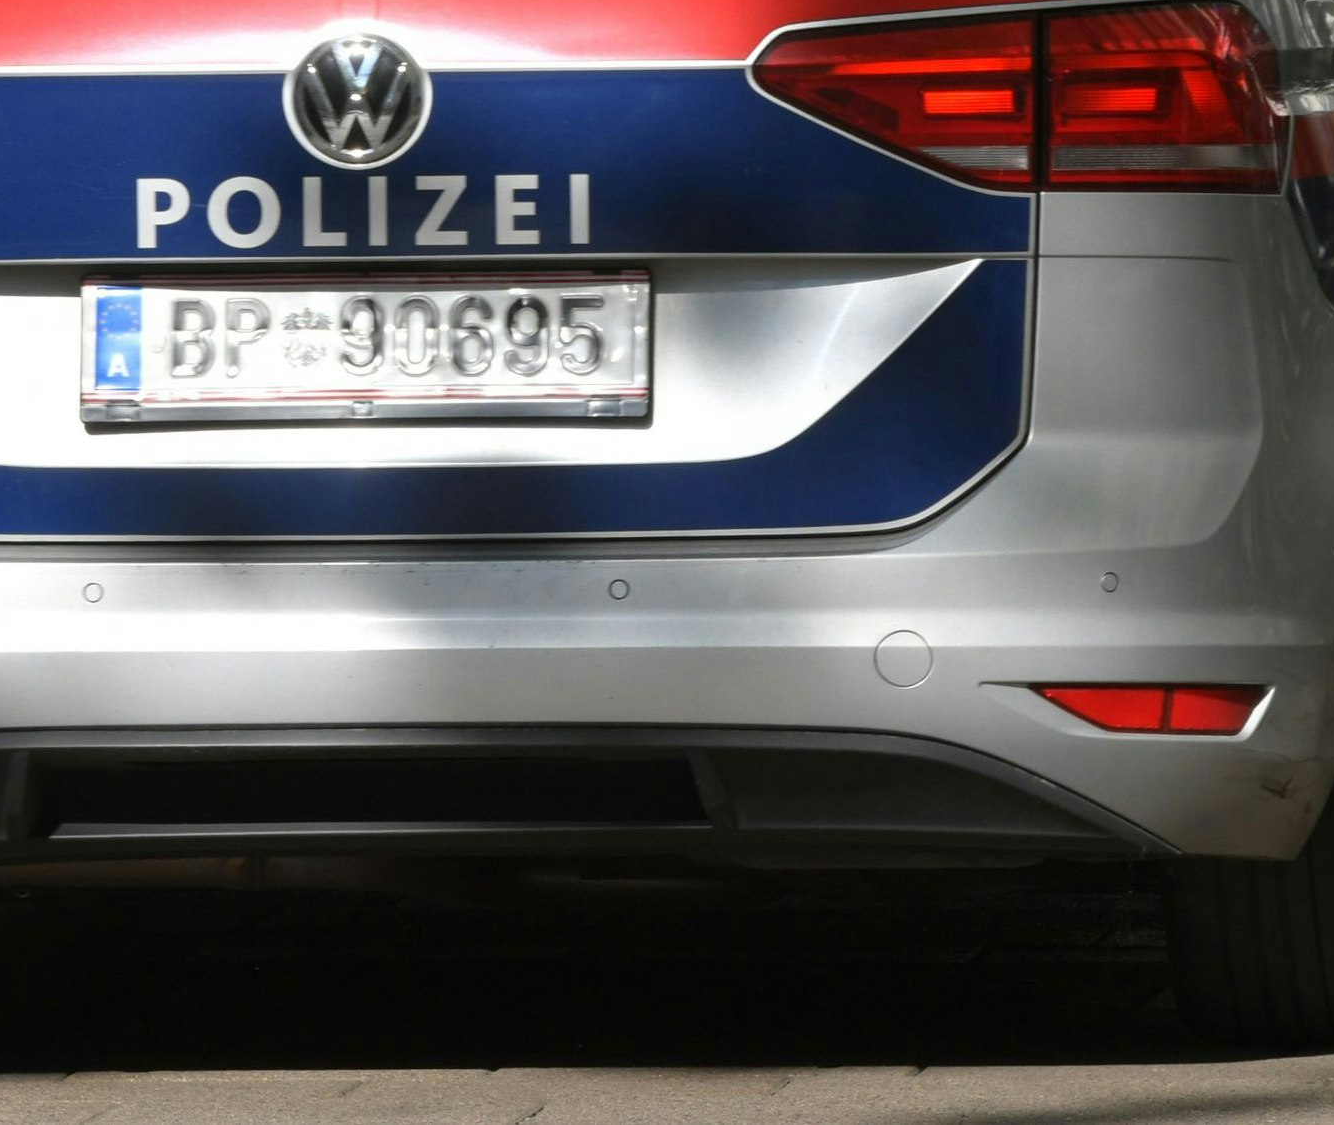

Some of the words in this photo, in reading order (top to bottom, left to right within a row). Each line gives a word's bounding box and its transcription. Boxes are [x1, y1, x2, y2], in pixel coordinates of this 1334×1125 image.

[136, 173, 591, 250] POLIZEI
[106, 354, 130, 378] A
[170, 297, 271, 379] BP
[339, 292, 605, 378] 90695
